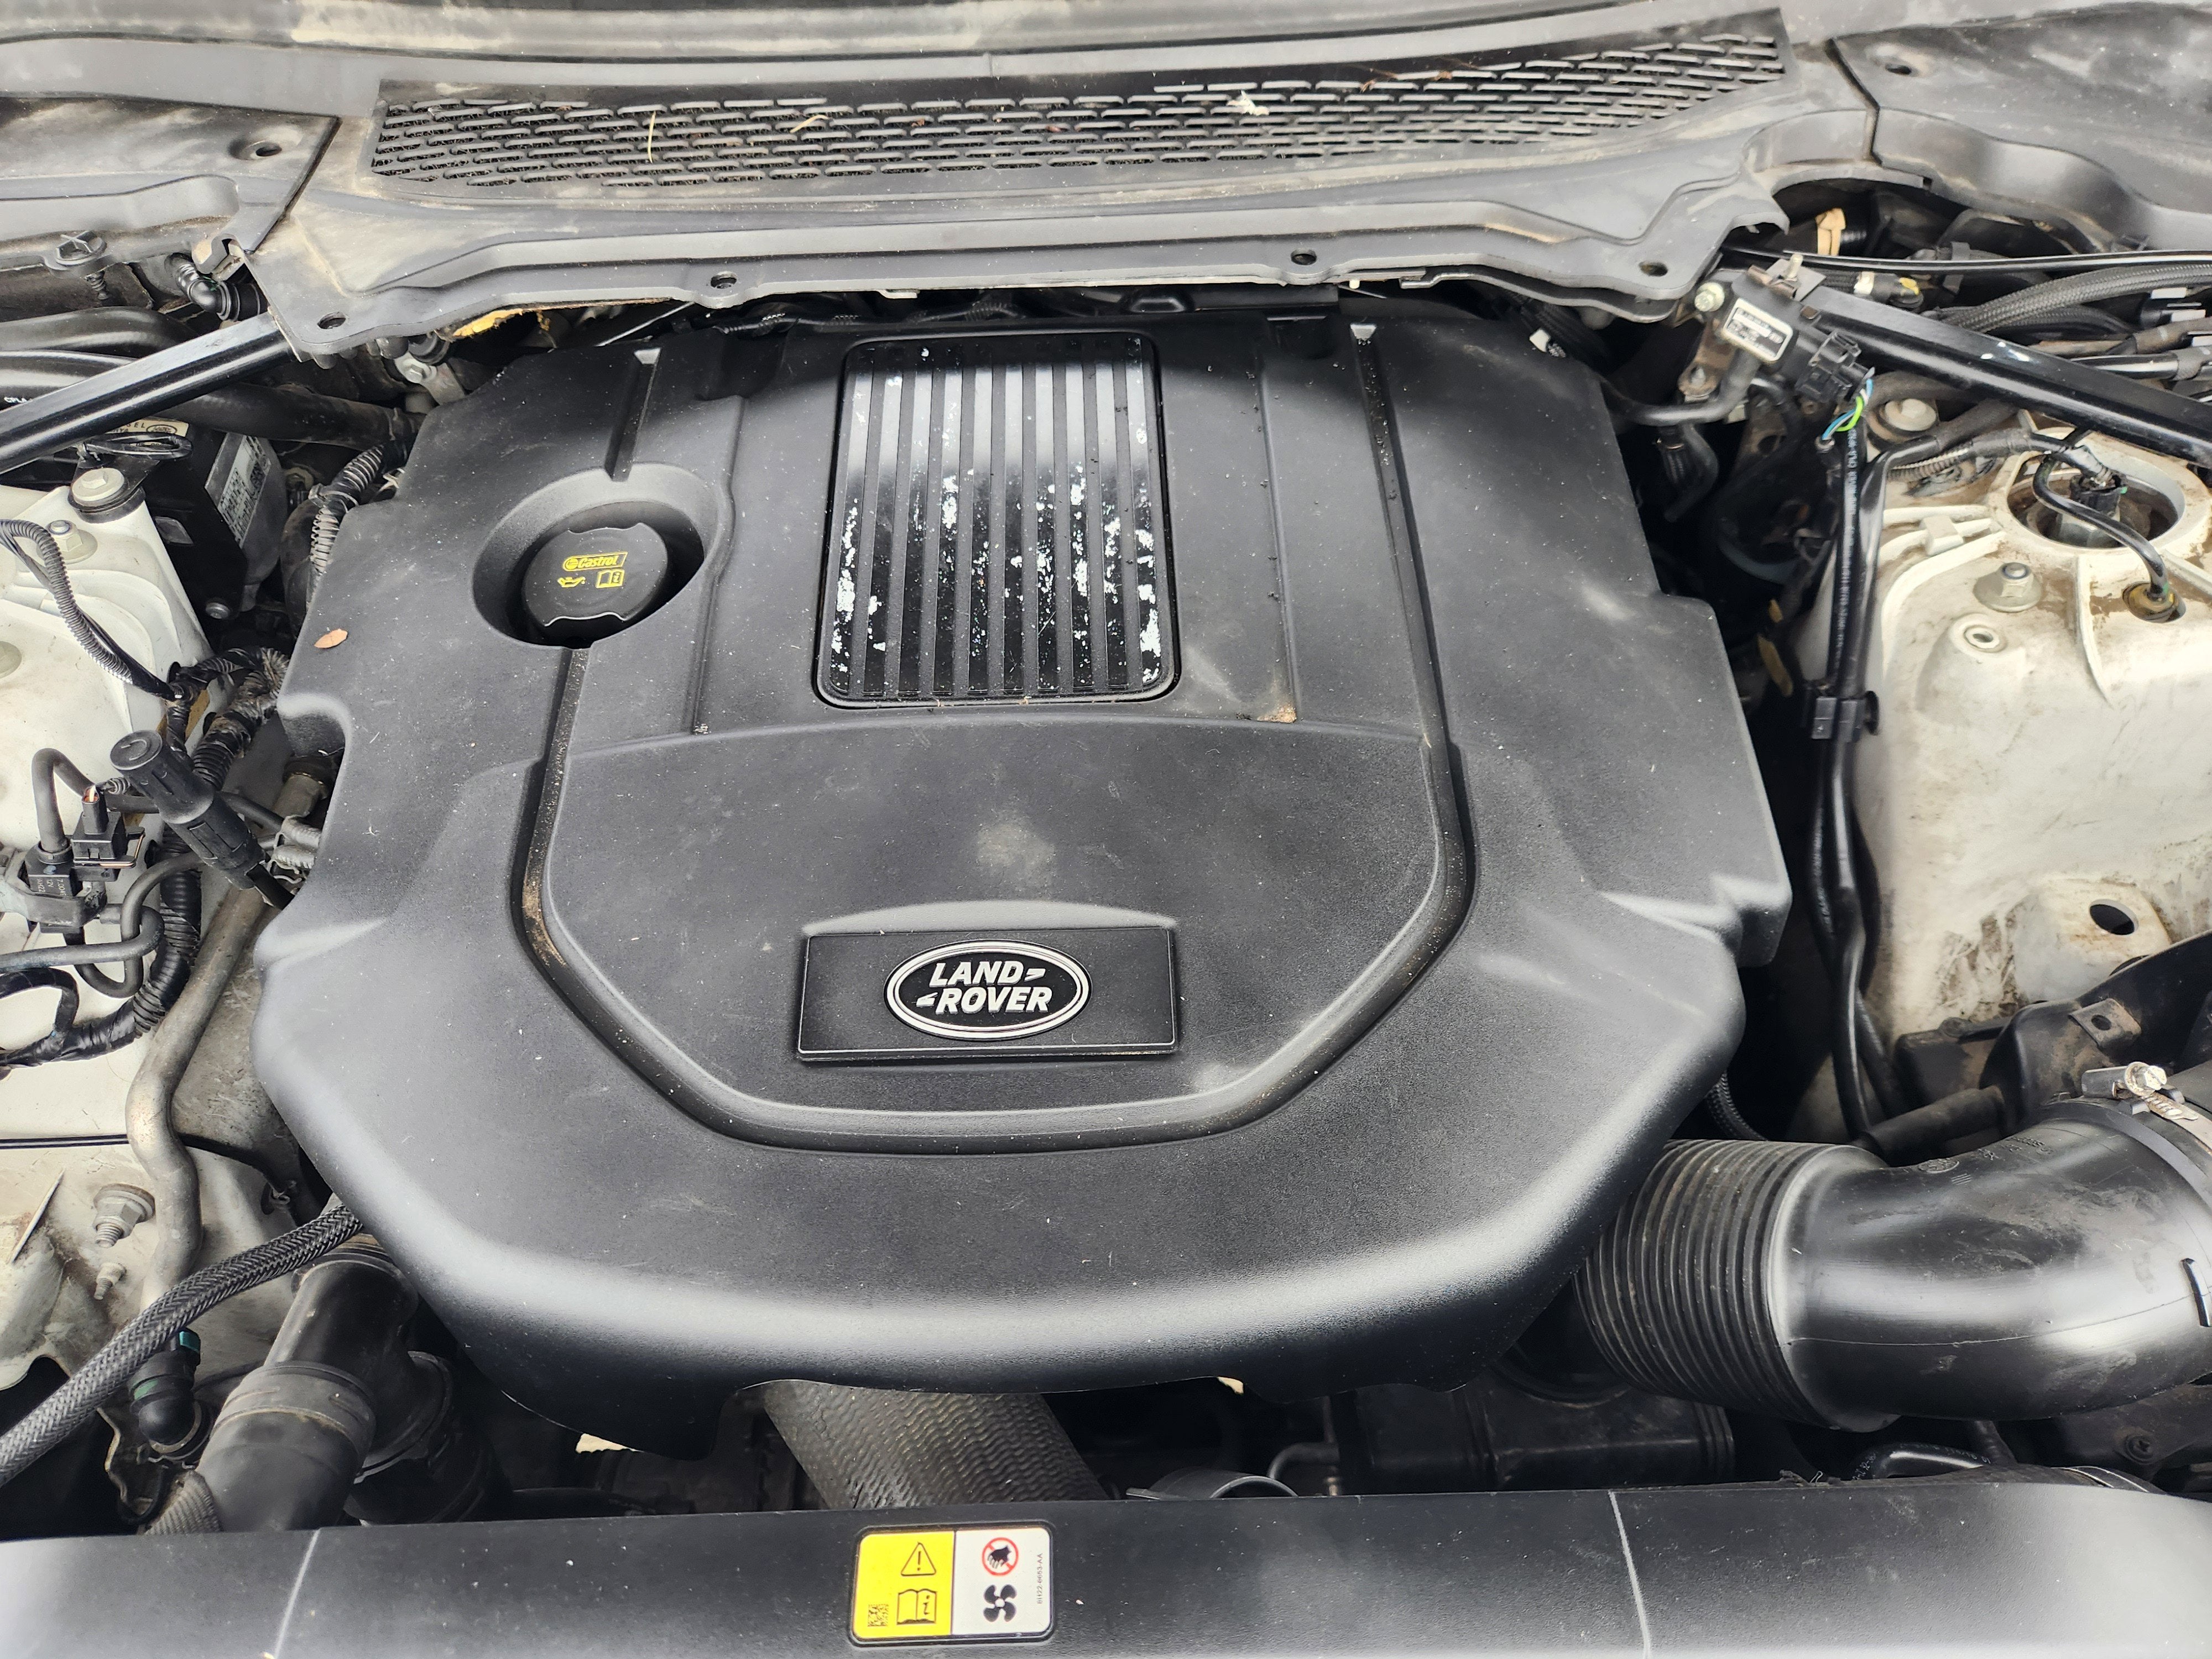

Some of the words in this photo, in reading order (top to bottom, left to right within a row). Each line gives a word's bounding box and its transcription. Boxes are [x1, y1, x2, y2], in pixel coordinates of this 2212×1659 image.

[577, 555, 619, 568] Castrol
[46, 879, 54, 888] 12V
[929, 960, 1024, 988] LAND
[935, 986, 1053, 1015] ROVER
